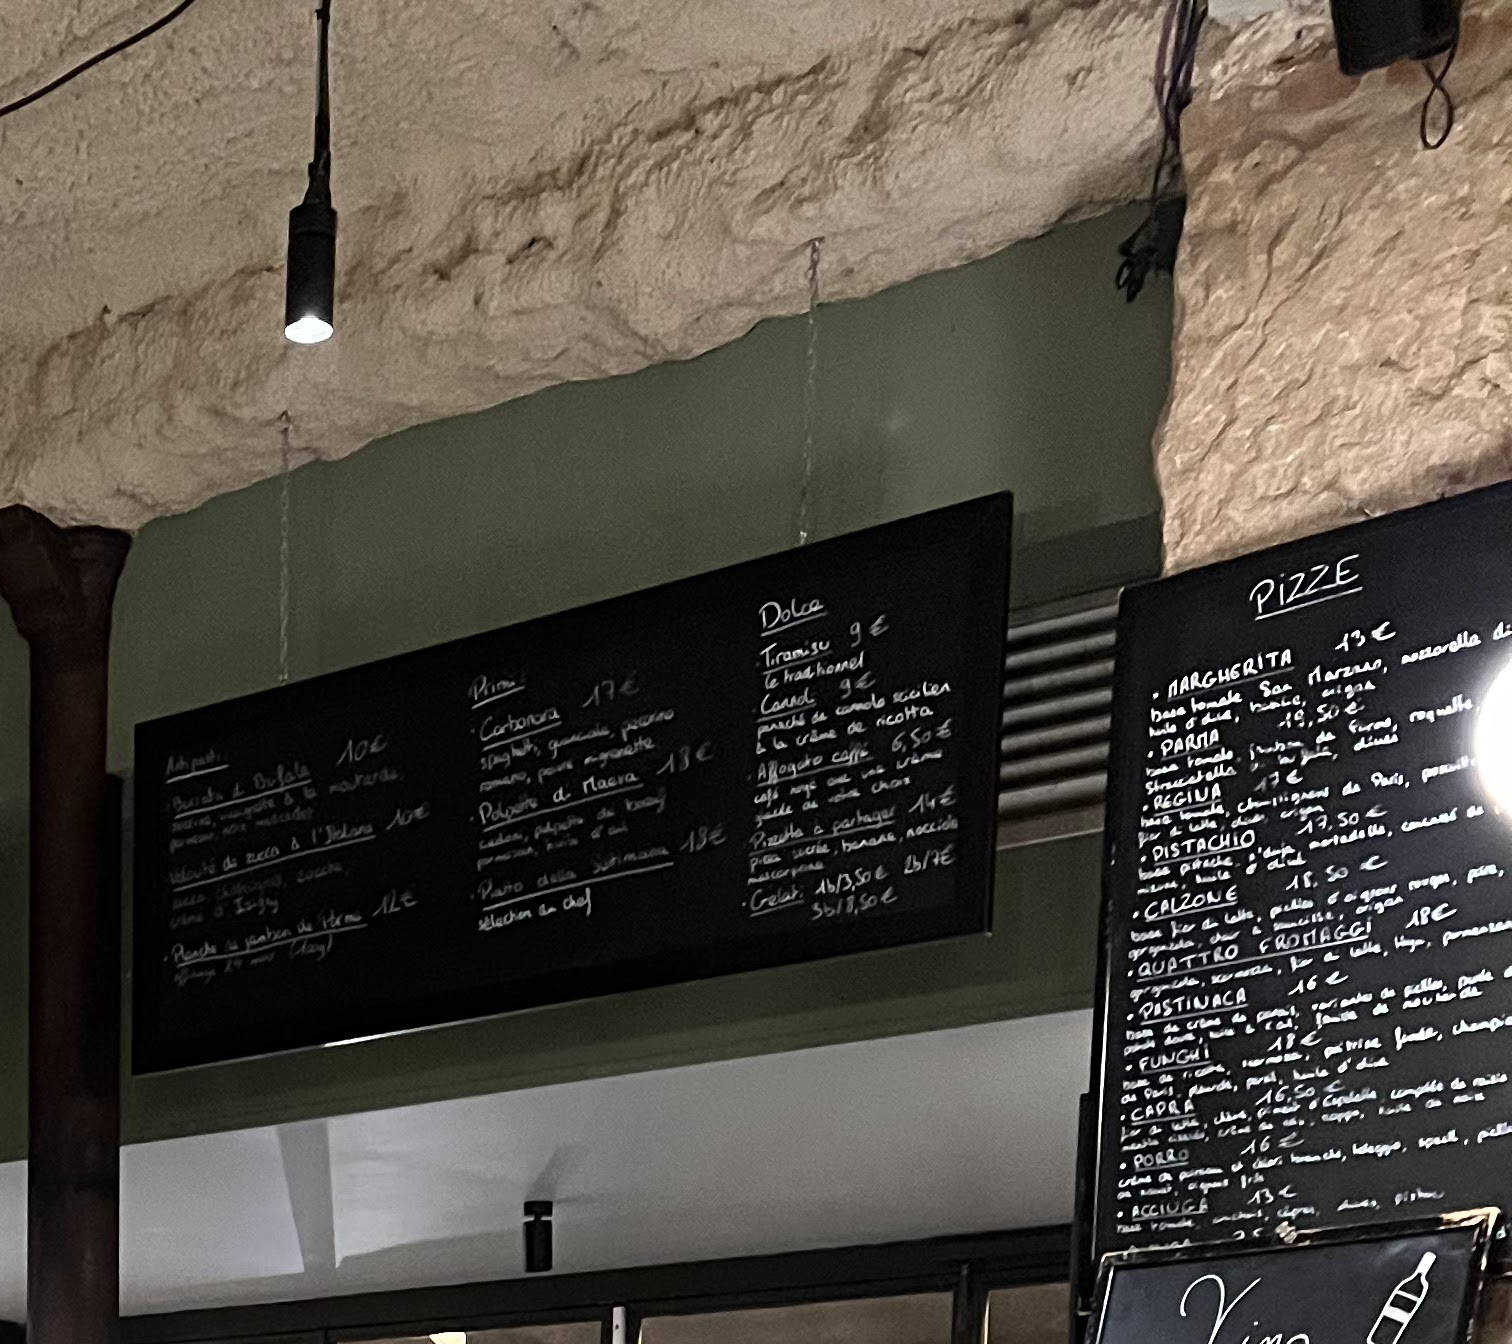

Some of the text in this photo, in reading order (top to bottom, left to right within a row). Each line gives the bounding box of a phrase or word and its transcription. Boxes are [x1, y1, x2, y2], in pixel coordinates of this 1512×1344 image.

[759, 599, 825, 629] Dolce
[761, 640, 830, 667] Tiramisu
[479, 706, 561, 741] Carbonara
[875, 704, 934, 727] ricotta
[1160, 729, 1220, 758] PARMA
[1144, 884, 1238, 920] CALZONE
[1137, 943, 1240, 978] QUATTRO
[1130, 1098, 1195, 1123] CAPRA
